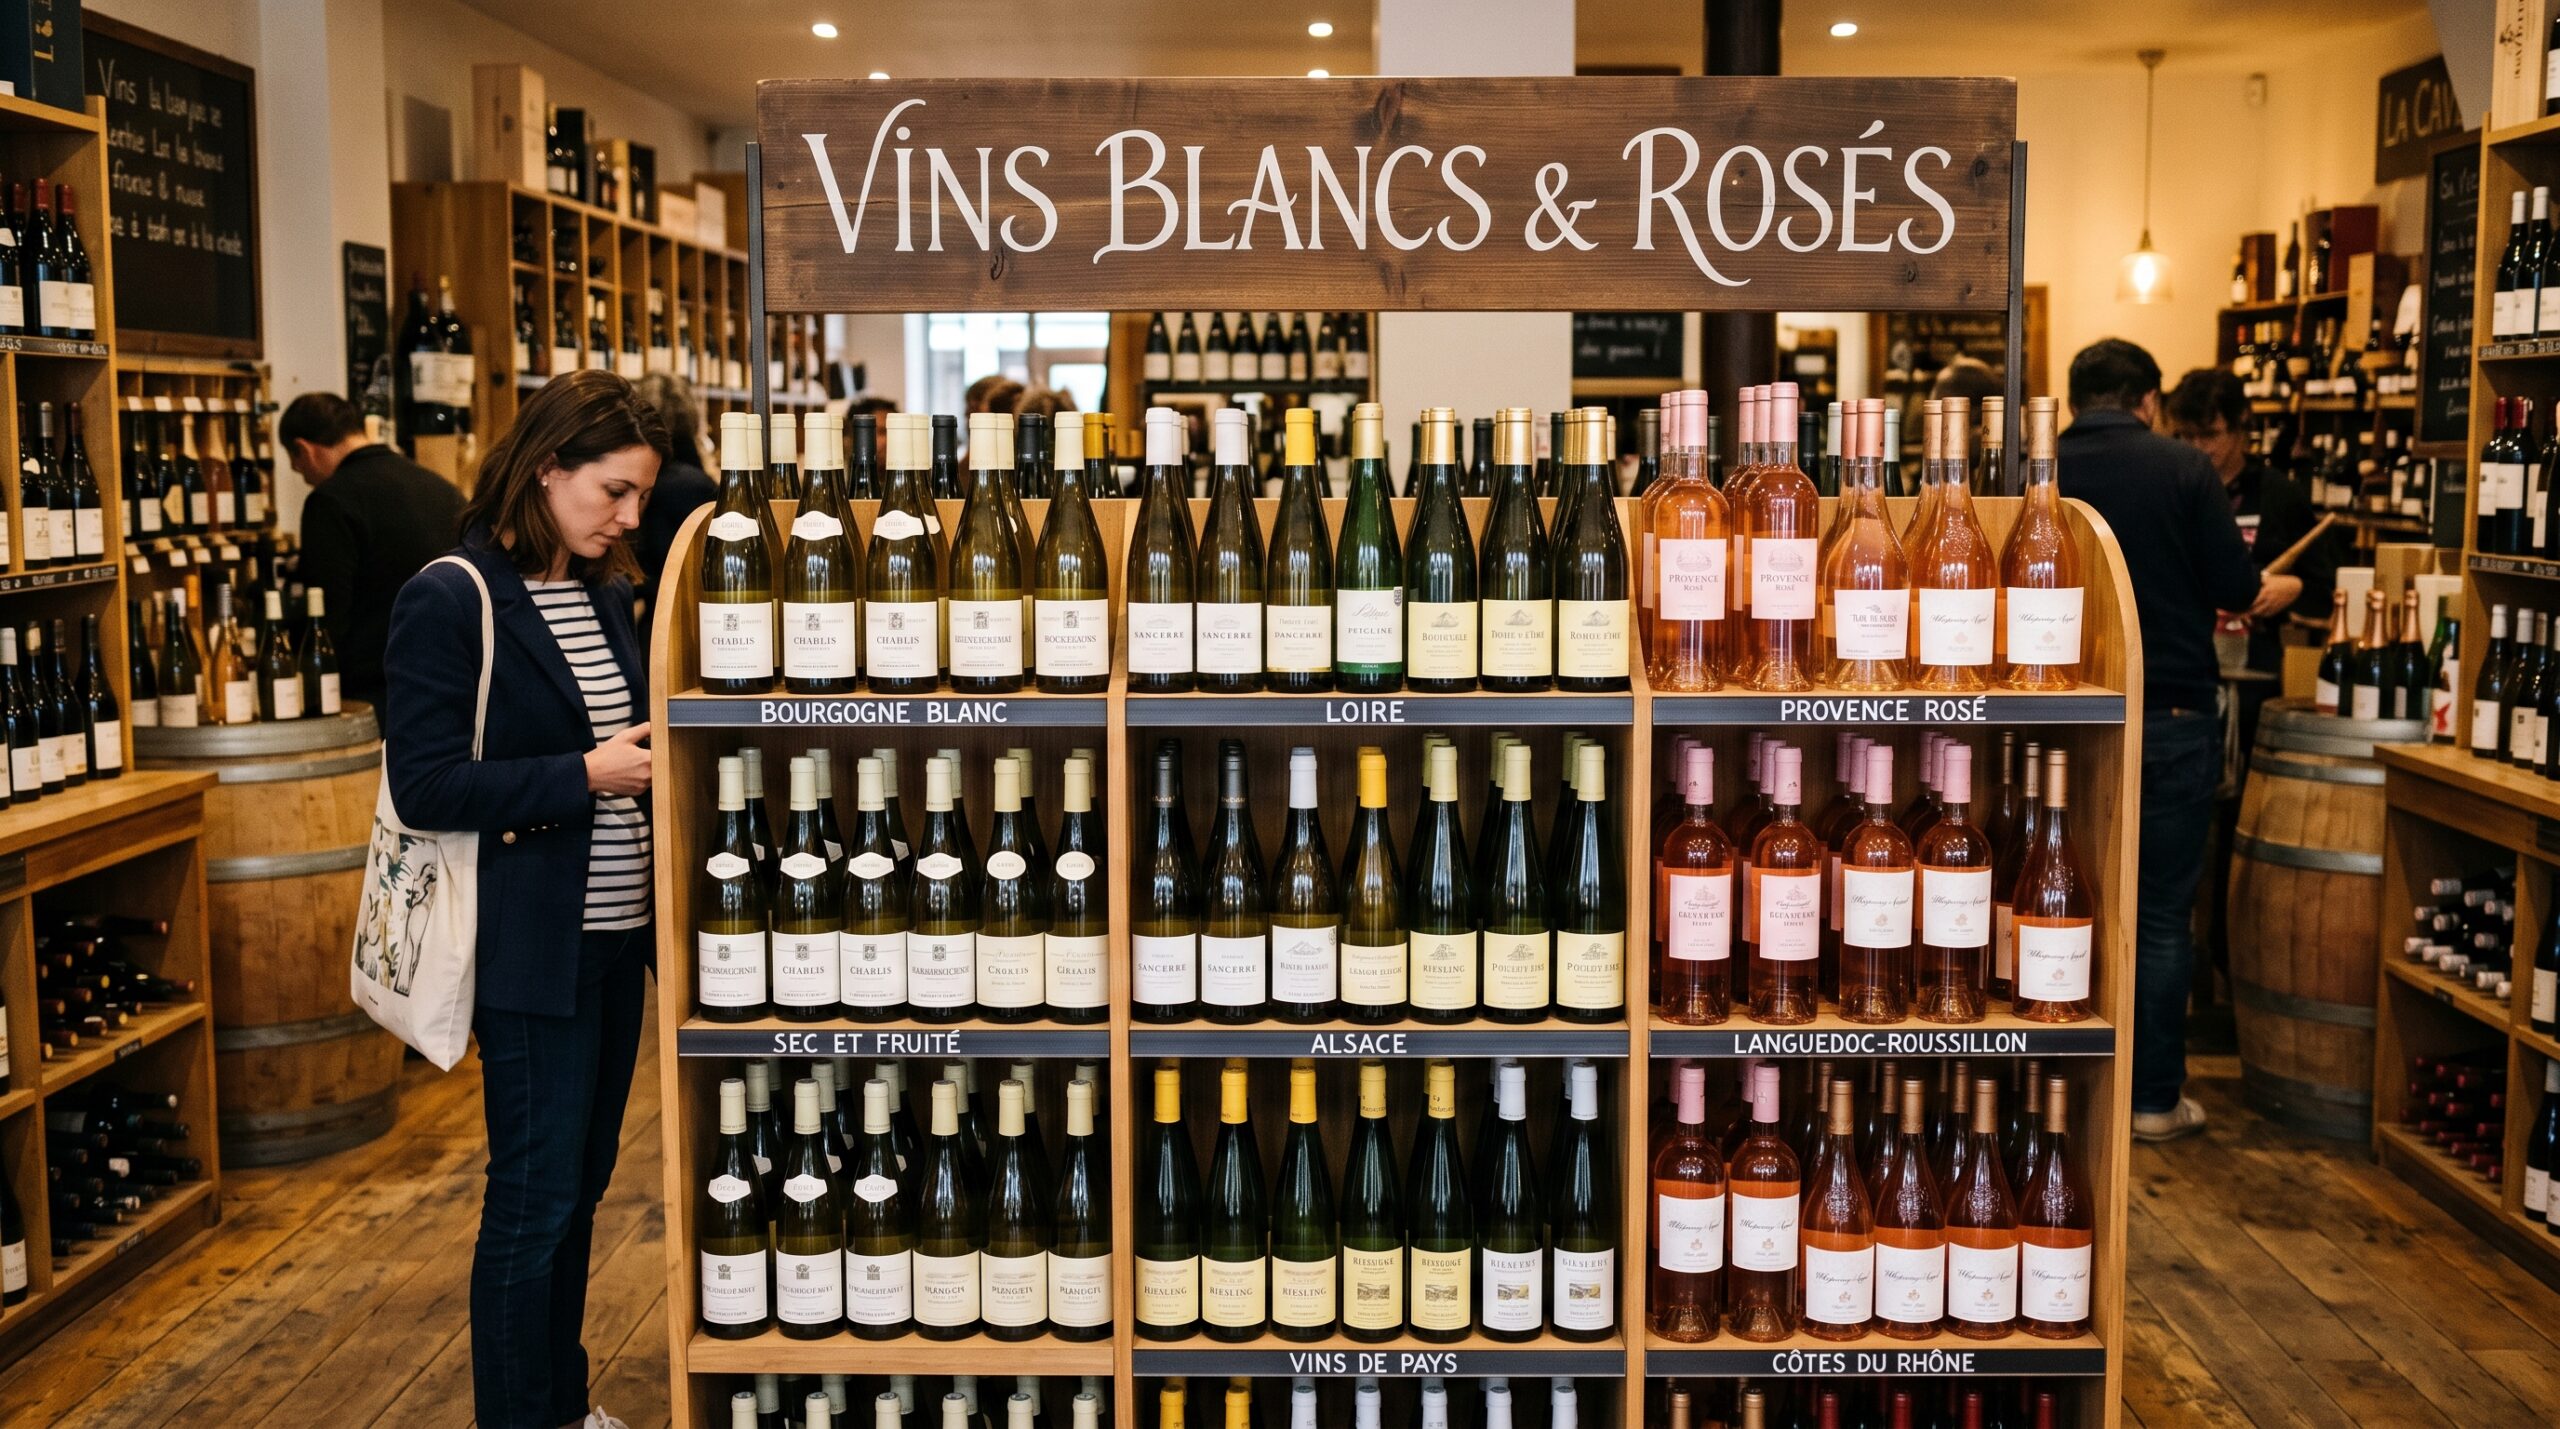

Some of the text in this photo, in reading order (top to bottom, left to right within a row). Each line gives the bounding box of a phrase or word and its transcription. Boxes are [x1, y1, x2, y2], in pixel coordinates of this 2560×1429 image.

[2413, 78, 2463, 138] CAV
[1093, 129, 1492, 264] BLANCS
[1524, 162, 1599, 251] &
[1622, 120, 1956, 286] ROSÉS
[1669, 574, 1719, 583] PROVENCE
[1760, 574, 1809, 583] PROVENCE
[1134, 631, 1184, 639] SANCERRE
[1202, 631, 1252, 640] SANCERRE
[711, 636, 756, 646] CHABLIS
[793, 636, 837, 646] CHABLIS
[876, 636, 920, 645] CHABLIS
[761, 702, 1008, 724] BOURGOGNE BLANC
[1326, 701, 1405, 723] LOIRE
[1781, 695, 1987, 721] PROVENCE ROSÉ
[1138, 963, 1187, 972] SANCERRE
[1207, 964, 1257, 974] SANCERRE
[1423, 964, 1465, 973] RIESLING
[773, 1030, 961, 1054] SEC ET FRUITÉ
[1311, 1033, 1407, 1054] ALSACE
[1734, 1033, 2027, 1054] LANGUEDOC-ROUSSILLON
[1209, 1286, 1253, 1296] RIESLING
[1282, 1286, 1327, 1296] RIESLING
[1289, 1353, 1458, 1374] VINS DE PAYS
[1772, 1348, 1975, 1373] CÔTES DU RHÔNE
